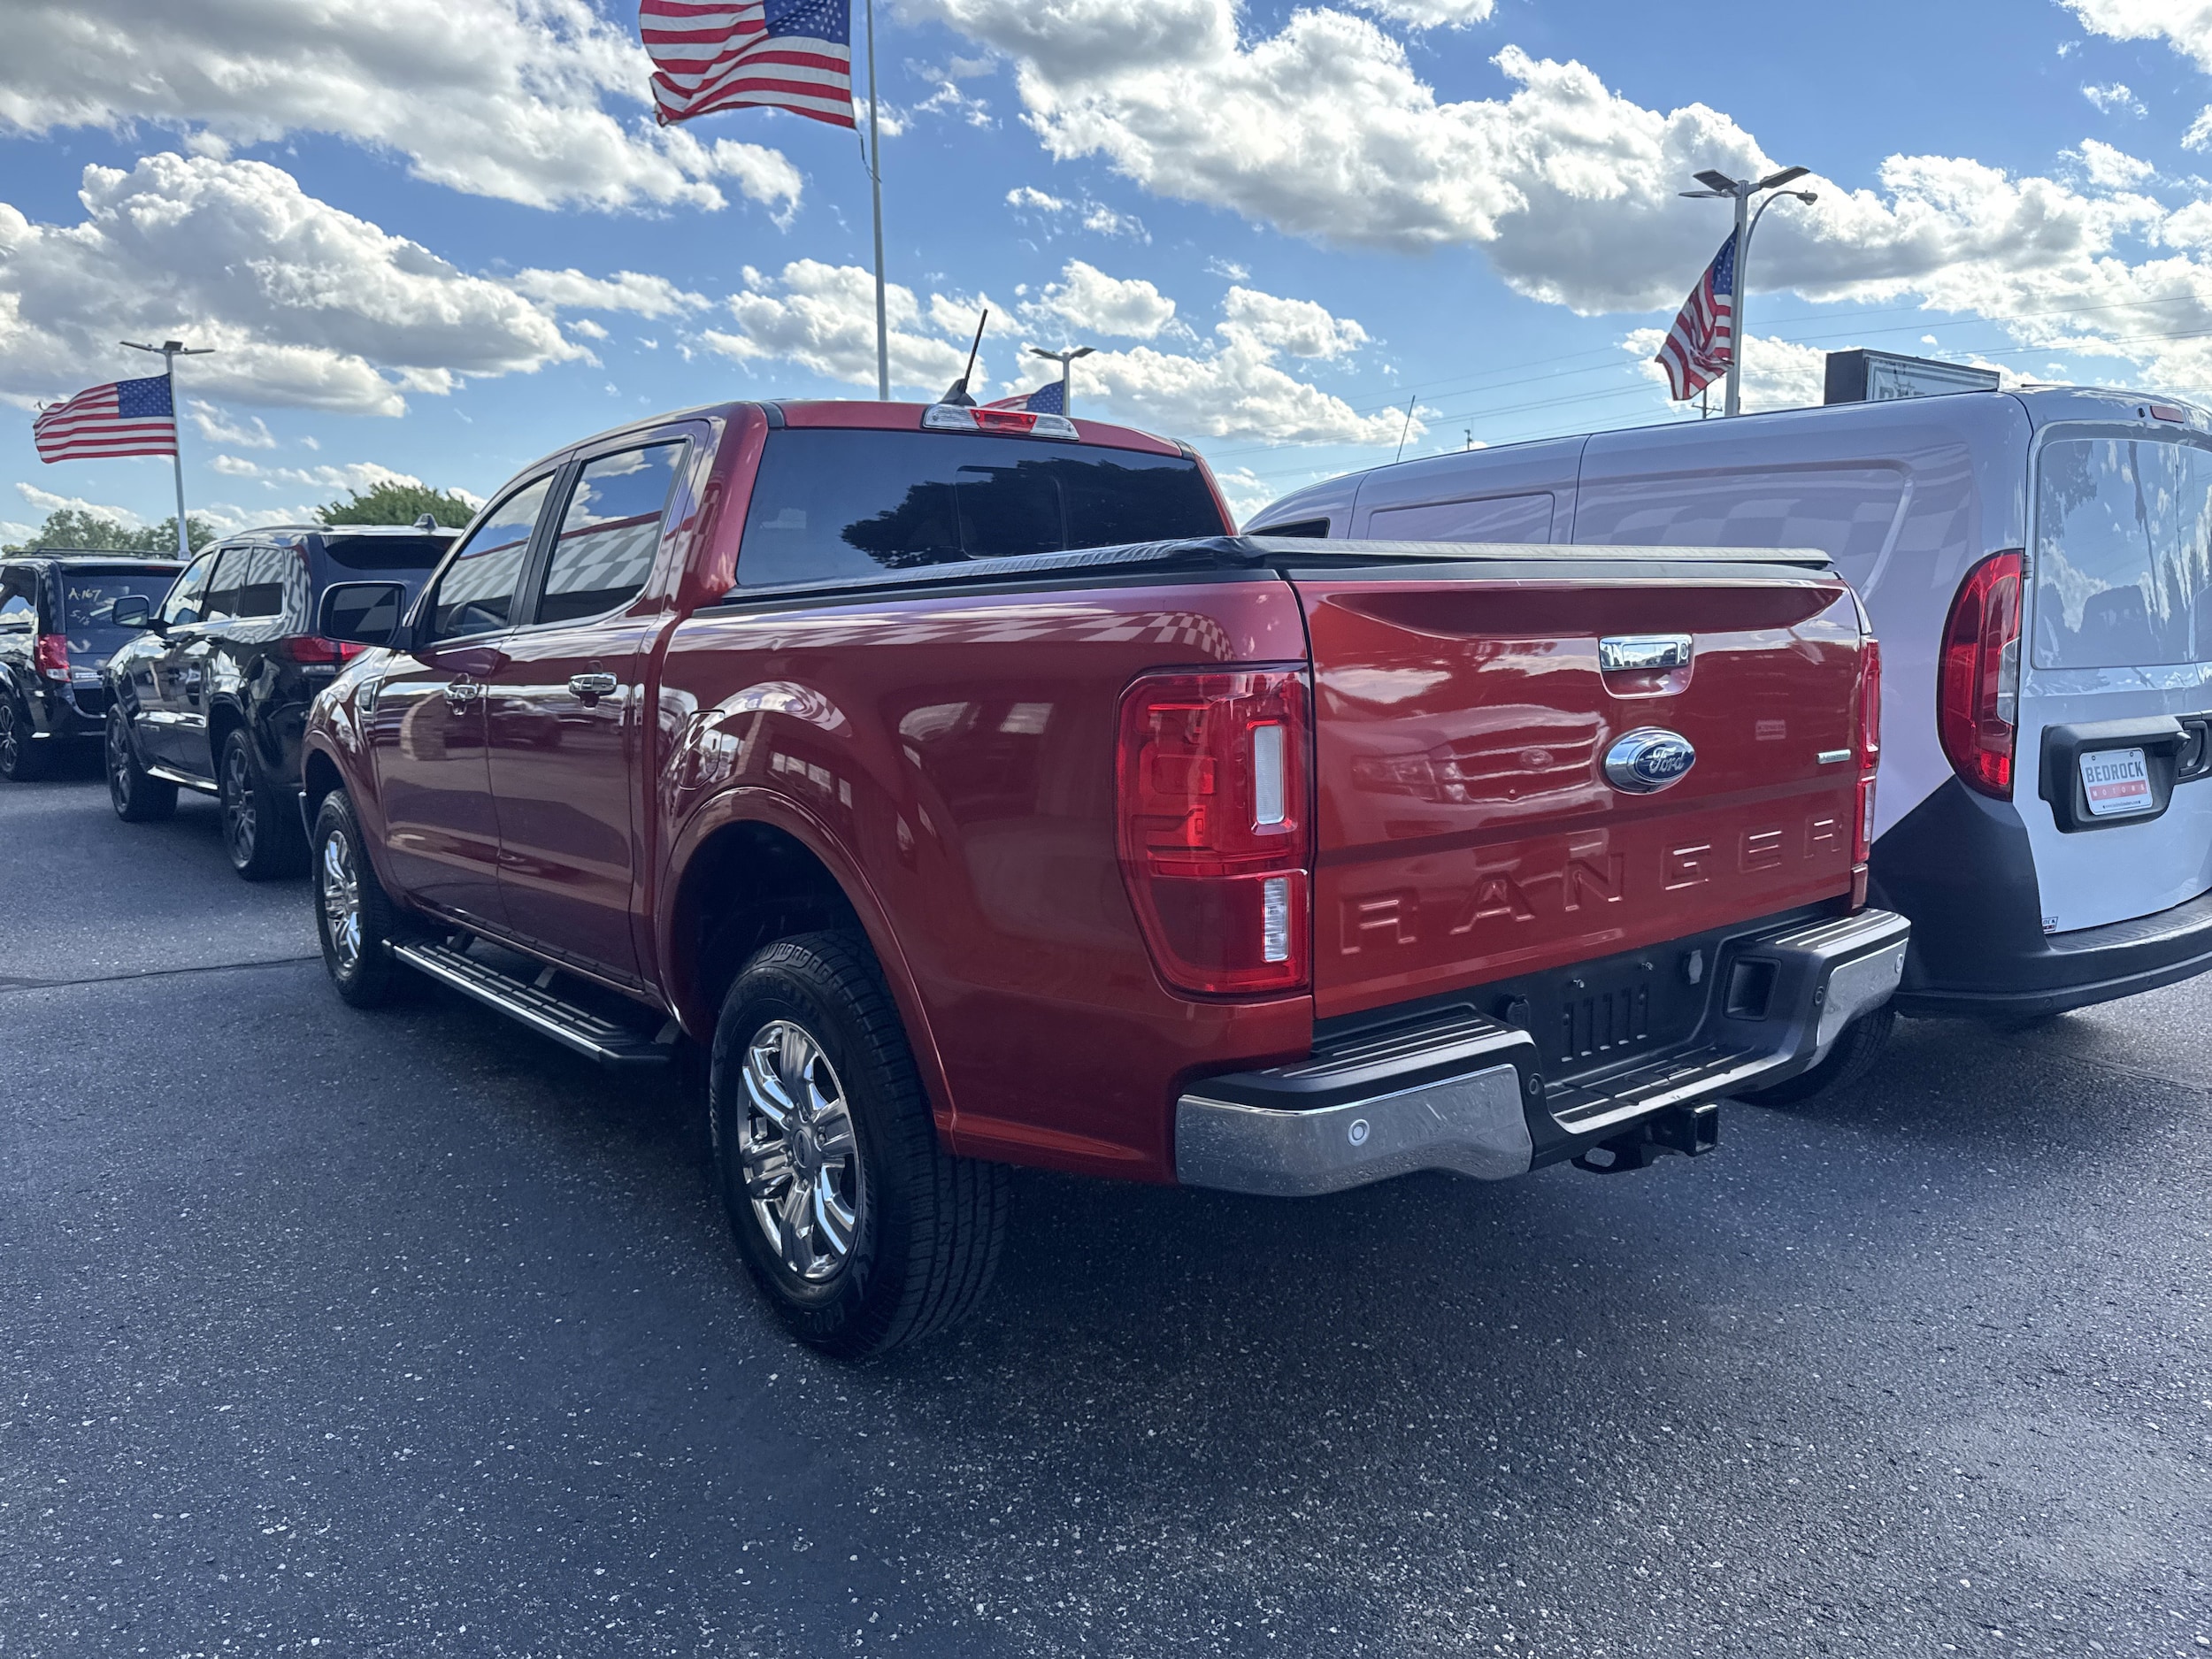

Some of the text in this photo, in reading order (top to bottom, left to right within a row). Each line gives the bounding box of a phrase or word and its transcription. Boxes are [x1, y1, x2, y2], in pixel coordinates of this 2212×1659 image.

[1648, 747, 1685, 774] Ford
[2085, 761, 2144, 783] BEDROCK
[2093, 783, 2146, 797] MOTORS
[1340, 815, 1843, 954] RANGER
